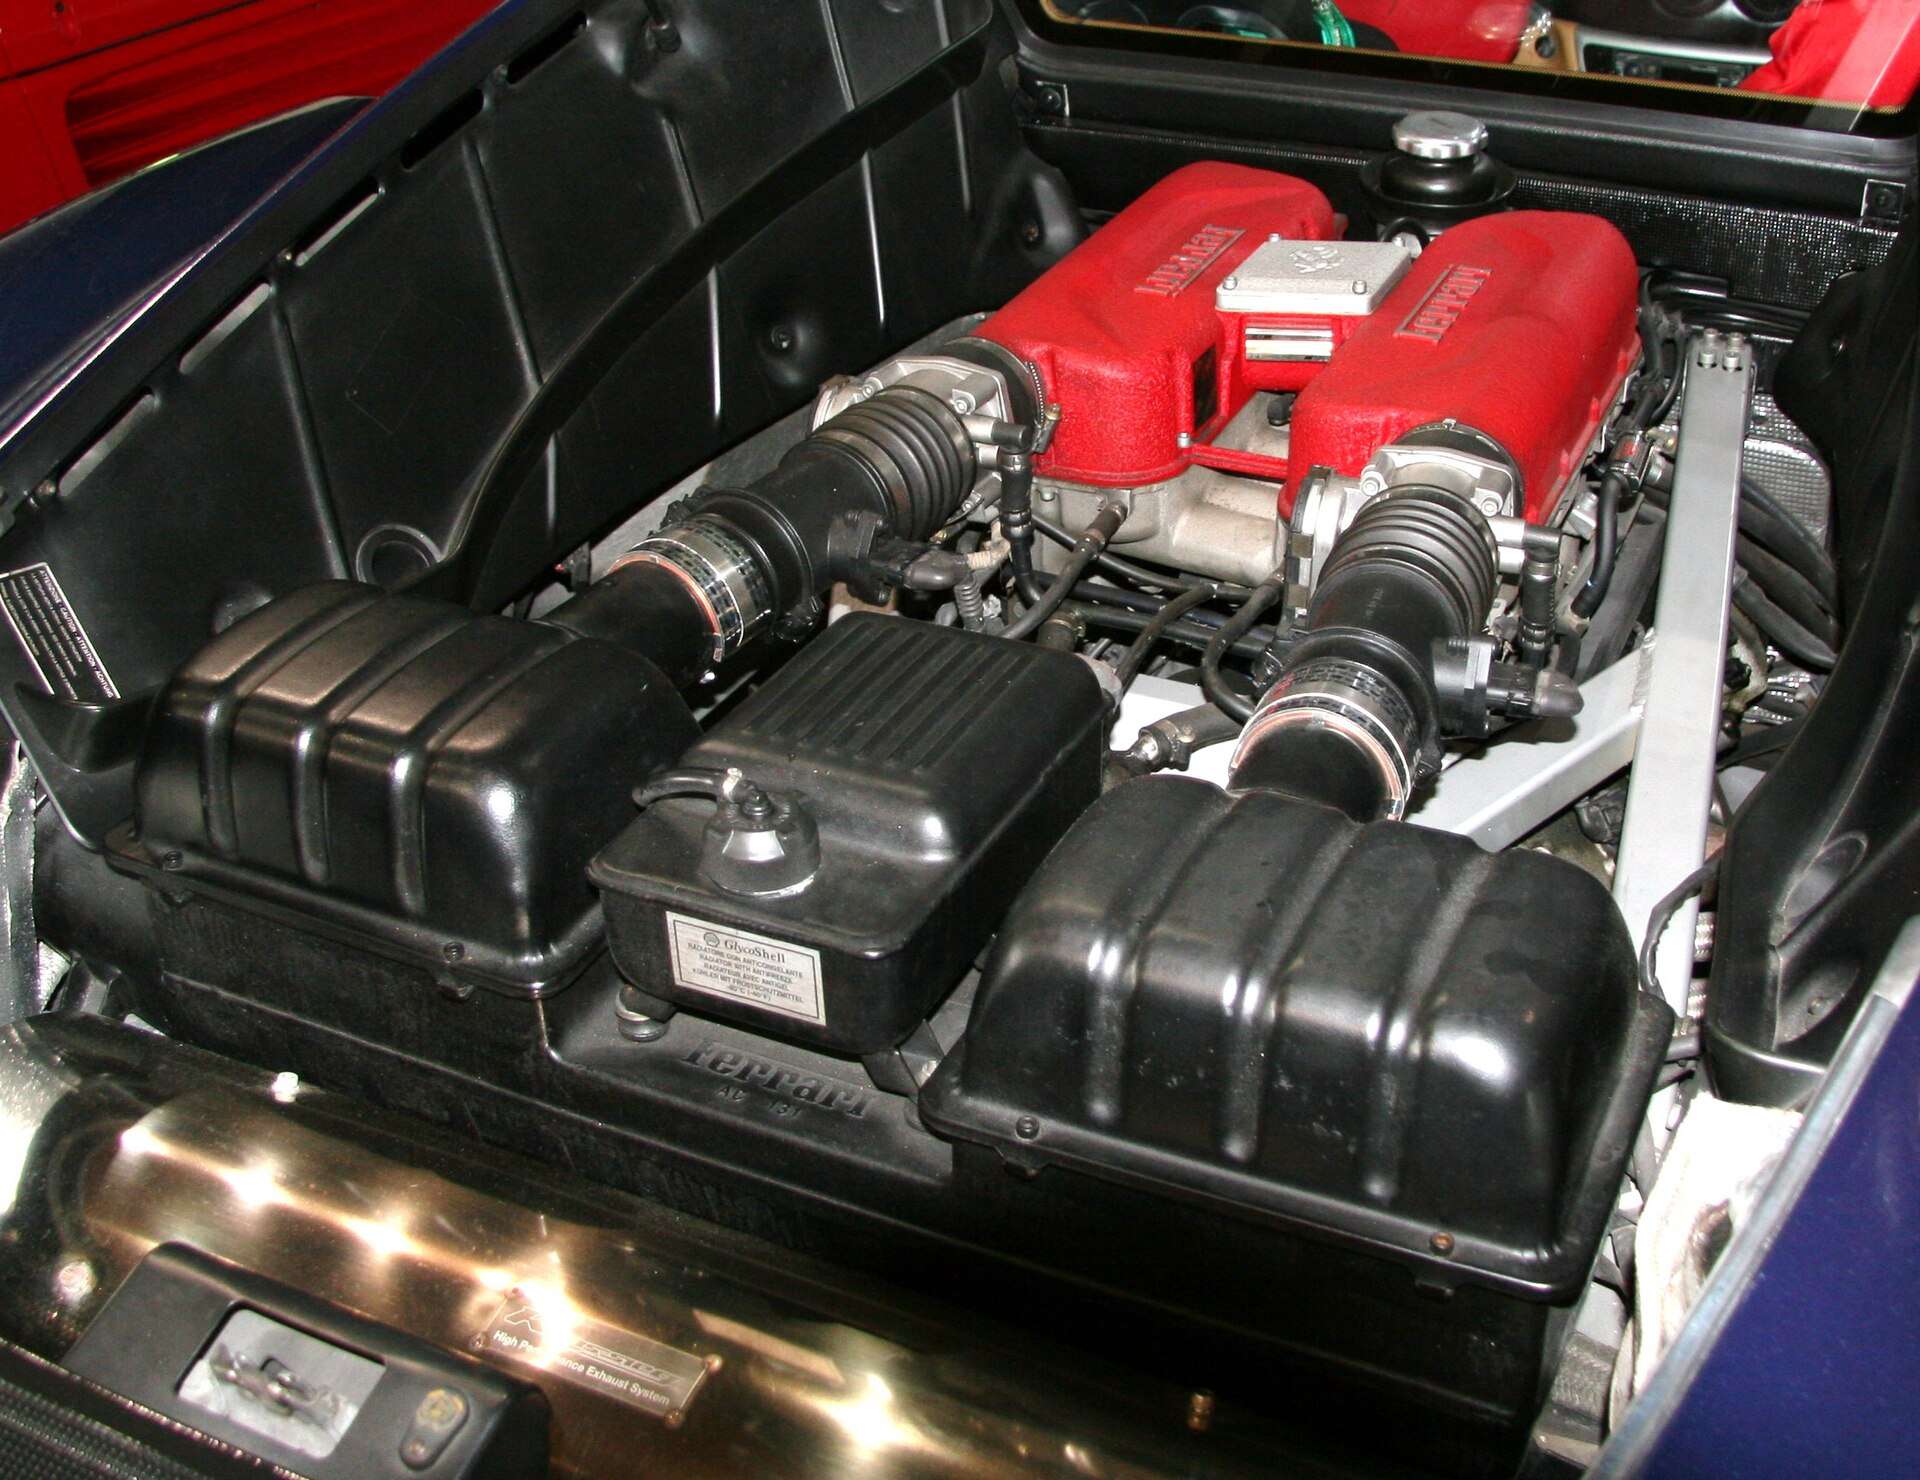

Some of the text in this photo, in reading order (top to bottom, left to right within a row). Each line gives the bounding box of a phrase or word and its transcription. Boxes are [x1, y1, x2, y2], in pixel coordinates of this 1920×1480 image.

[1134, 224, 1246, 298] Ferrari
[1393, 264, 1493, 346] Ferrari
[59, 607, 78, 631] CAUTION
[75, 636, 97, 666] ATTENTION
[94, 670, 114, 697] ACHTUNG
[724, 939, 785, 963] GlycoShell
[681, 1040, 867, 1118] Ferrari
[493, 1329, 518, 1347] High
[585, 1365, 630, 1390] Exhaust
[630, 1382, 670, 1405] System
